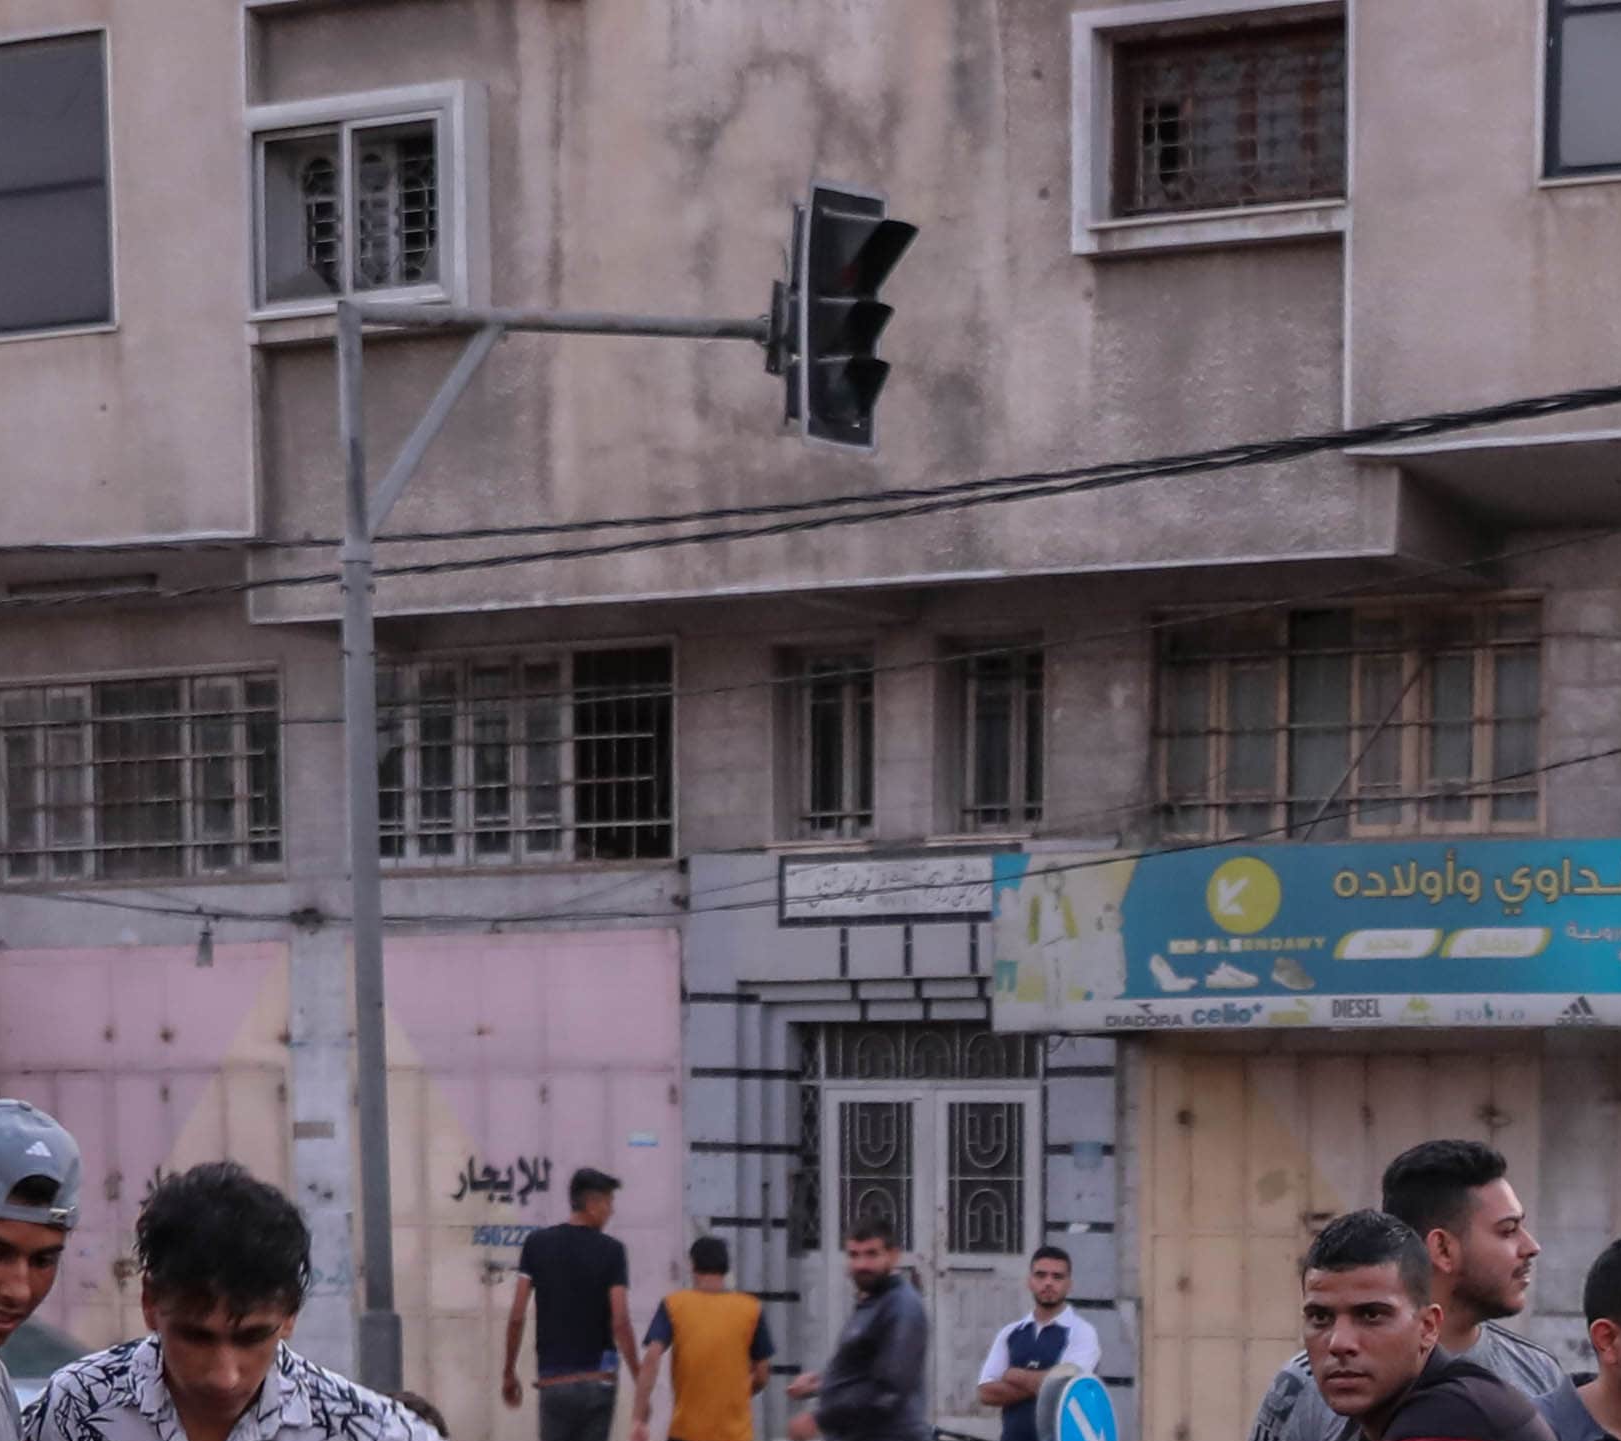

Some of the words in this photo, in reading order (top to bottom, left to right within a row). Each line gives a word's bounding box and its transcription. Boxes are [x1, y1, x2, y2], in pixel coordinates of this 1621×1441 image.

[1332, 847, 1483, 905] وأولاده
[1105, 1014, 1184, 1028] DIADORA
[1331, 999, 1382, 1019] DIESEL
[451, 1154, 553, 1207] للإيجار
